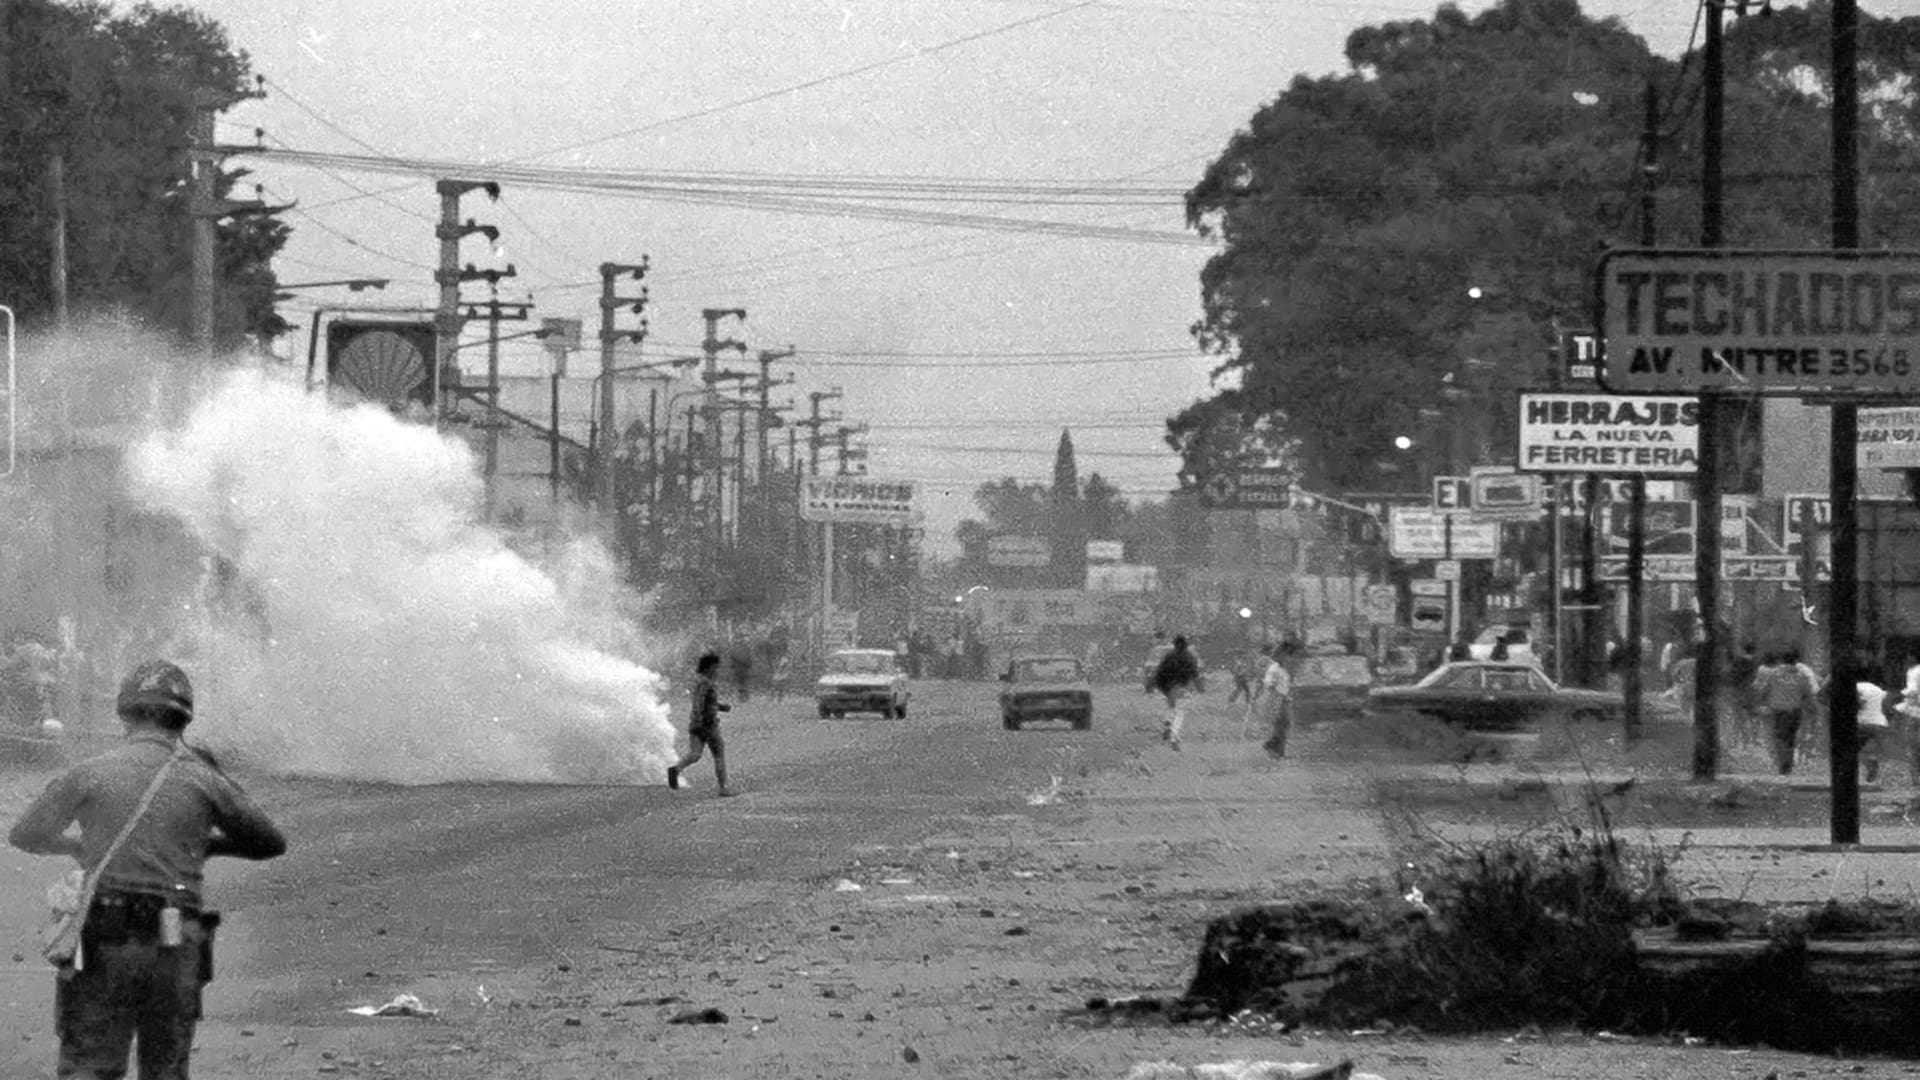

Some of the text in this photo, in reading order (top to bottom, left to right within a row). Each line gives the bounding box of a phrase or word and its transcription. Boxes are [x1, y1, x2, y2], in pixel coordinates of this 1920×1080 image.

[1616, 271, 1920, 336] TECHADOS
[1629, 348, 1684, 374] AV.
[1702, 348, 1820, 374] MITRE
[1527, 400, 1701, 427] HERRAJES
[1553, 430, 1674, 442] LA NUEVA
[1527, 445, 1699, 466] FERRETERIA
